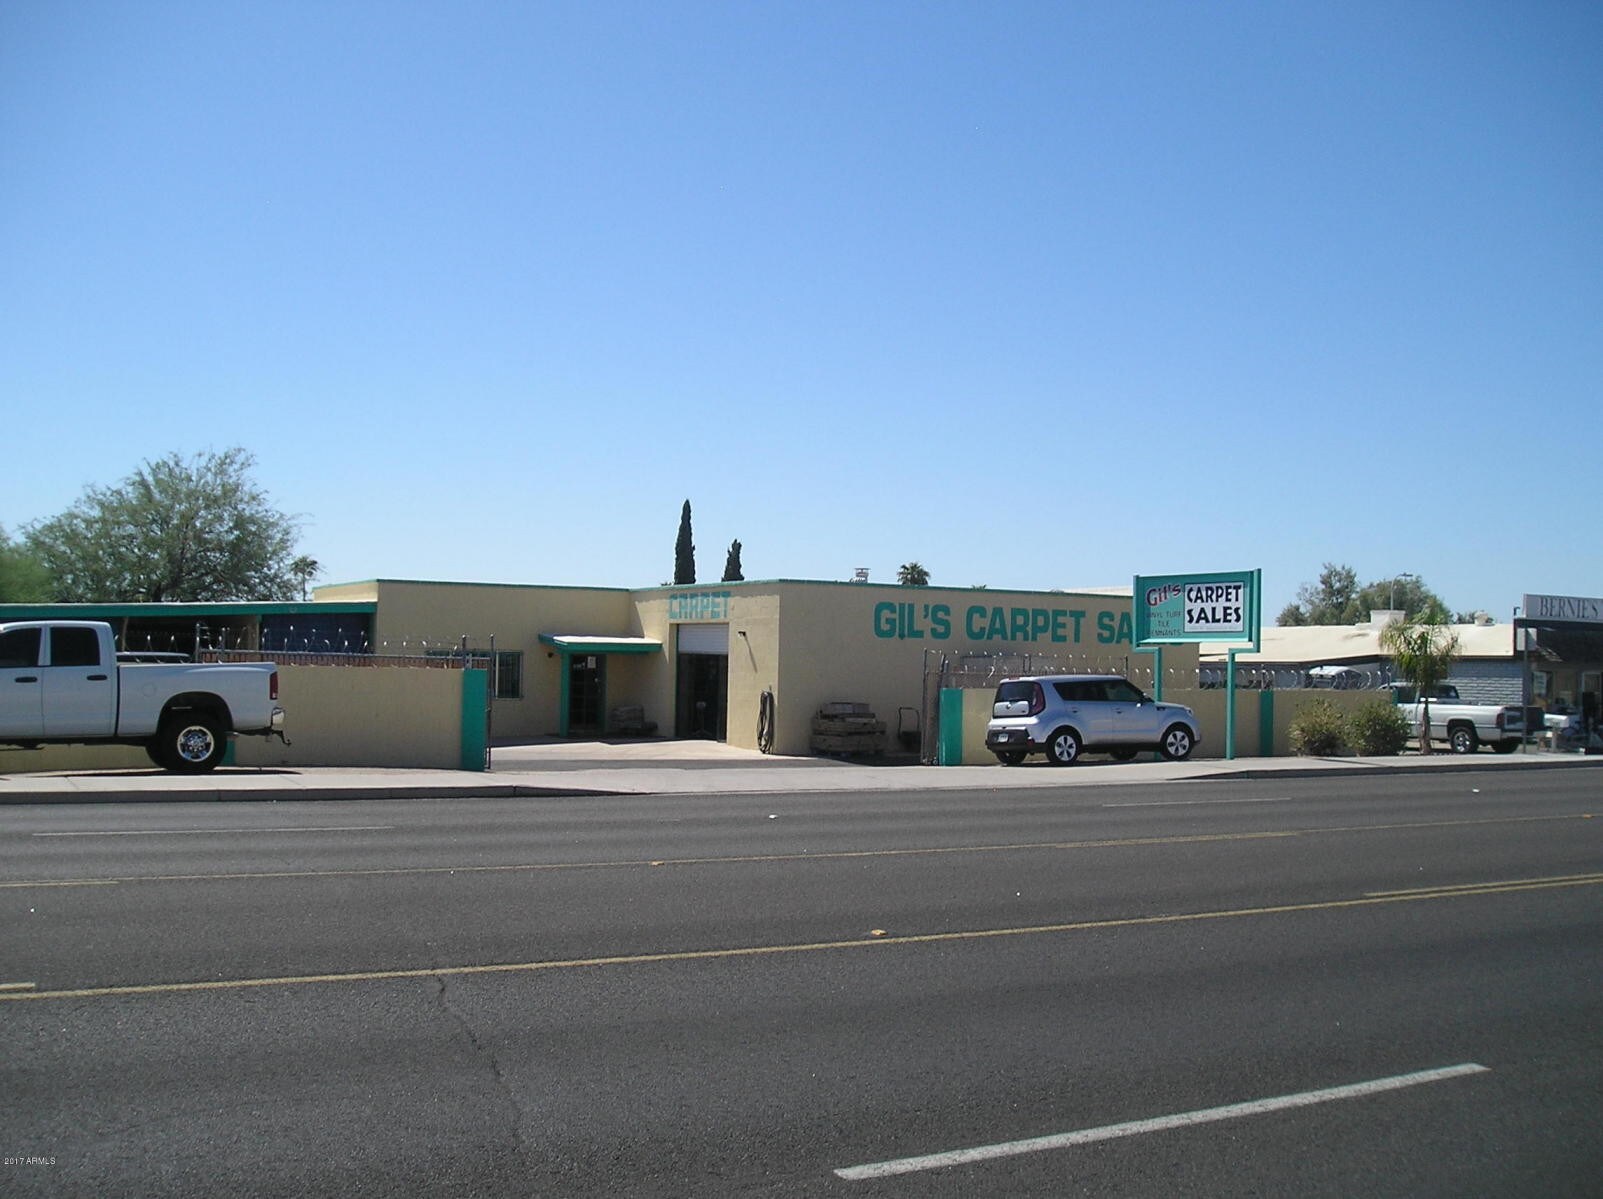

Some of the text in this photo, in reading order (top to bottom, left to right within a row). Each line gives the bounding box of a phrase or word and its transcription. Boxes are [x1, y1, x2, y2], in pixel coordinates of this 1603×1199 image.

[668, 591, 731, 619] CARPET
[1146, 583, 1182, 606] Gil's
[1187, 584, 1242, 603] CARPET
[873, 601, 951, 640] GIL'S
[966, 605, 1086, 643] CARPET
[1187, 606, 1242, 624] SALES
